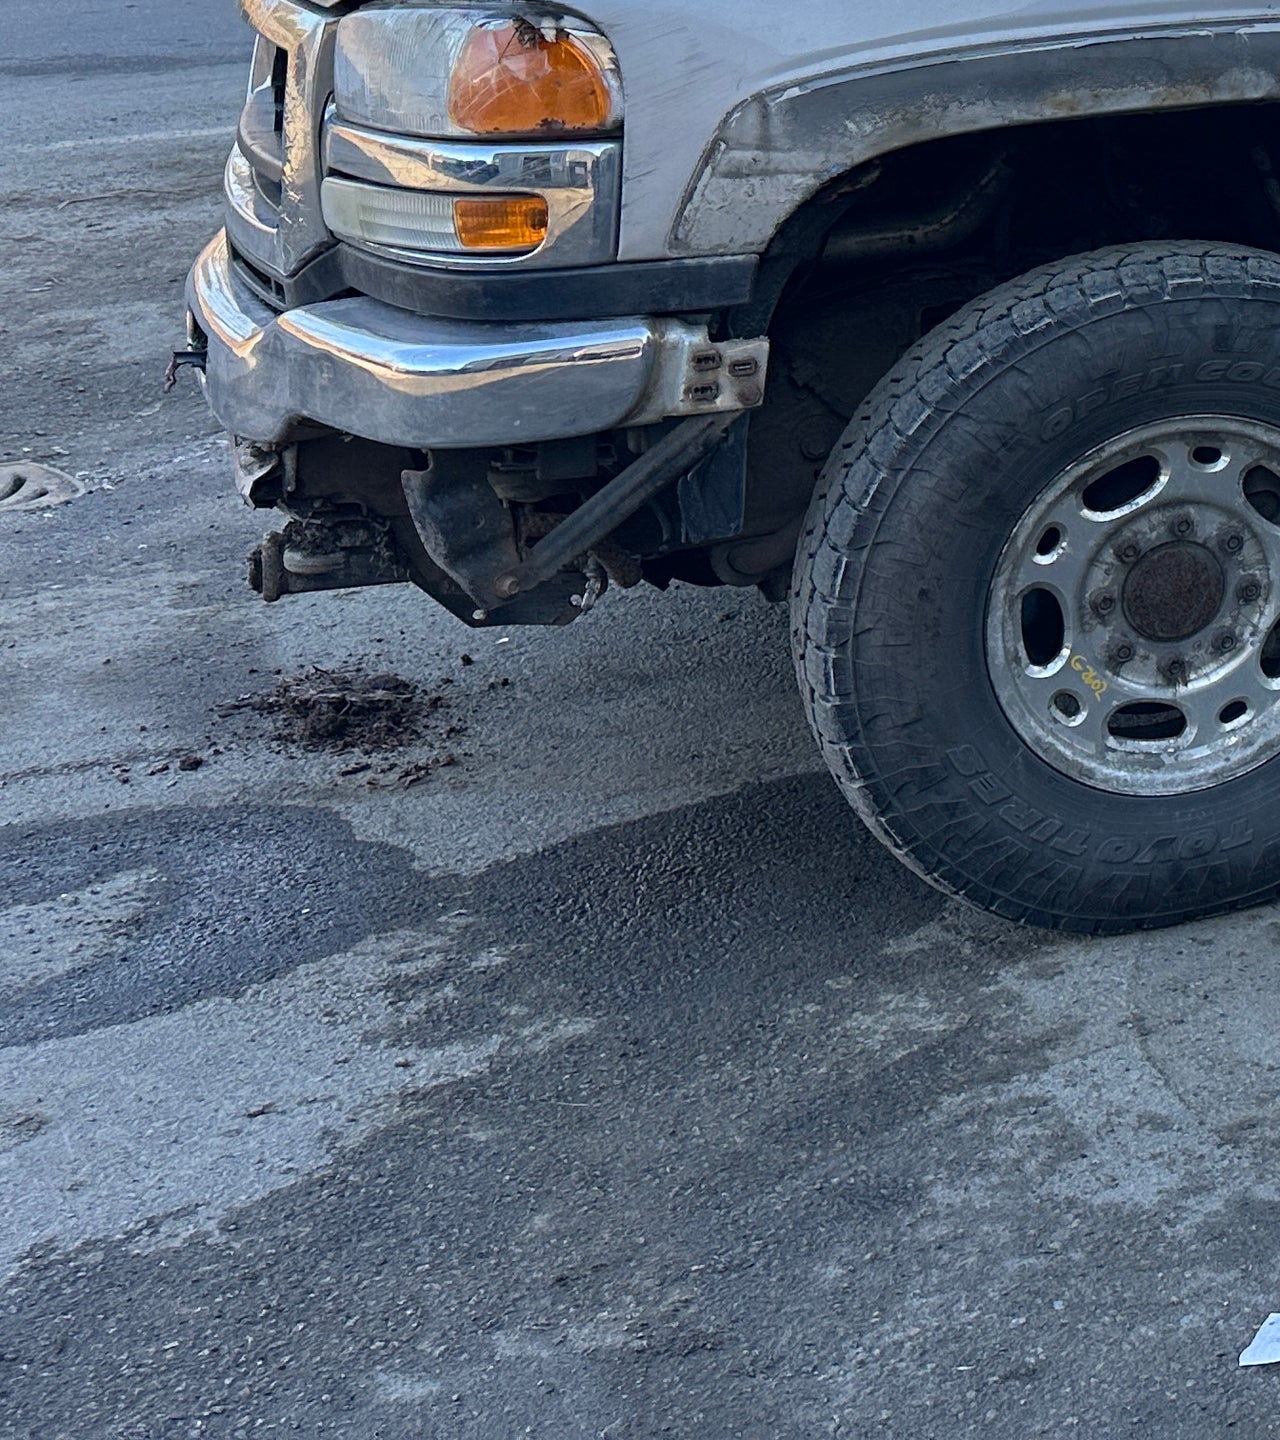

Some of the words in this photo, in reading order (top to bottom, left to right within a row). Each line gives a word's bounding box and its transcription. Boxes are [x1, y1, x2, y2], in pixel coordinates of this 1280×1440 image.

[1039, 359, 1184, 440] OPEN
[945, 743, 1092, 857] TIRES
[1096, 818, 1255, 864] TOYO
